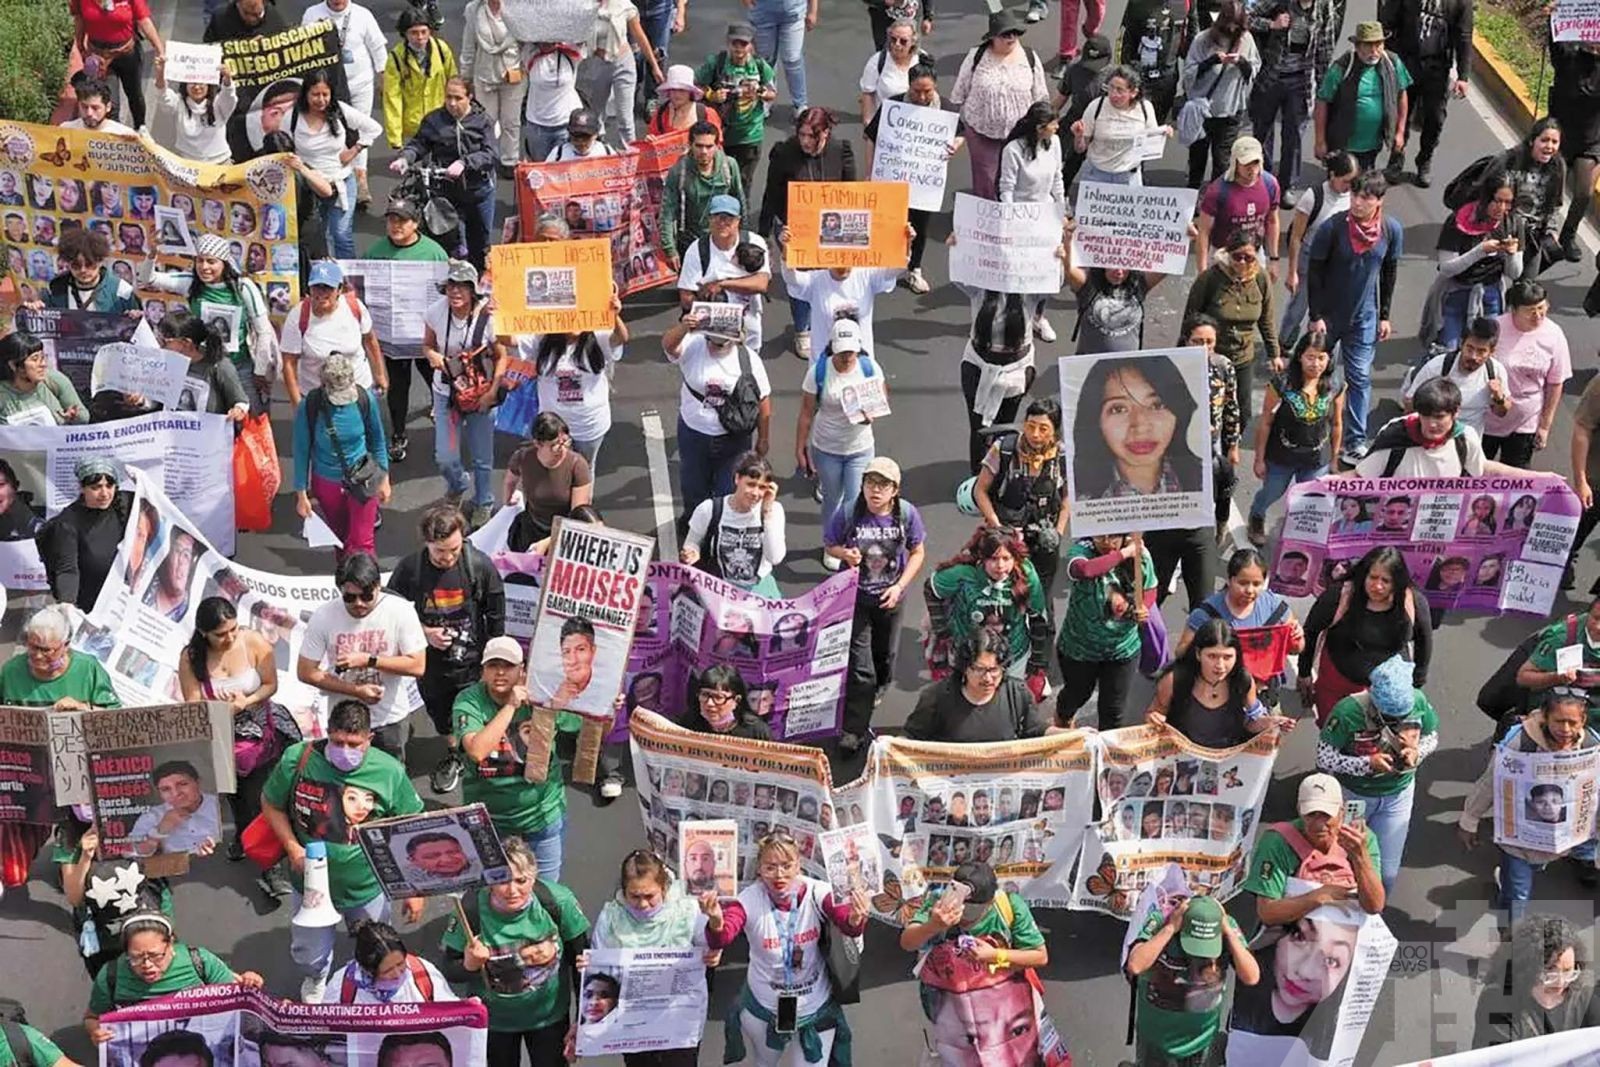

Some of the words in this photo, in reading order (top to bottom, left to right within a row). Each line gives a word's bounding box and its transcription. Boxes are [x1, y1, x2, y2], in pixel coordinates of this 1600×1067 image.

[223, 40, 259, 55] SIGO
[261, 18, 334, 51] BUSCANDO
[223, 52, 280, 76] DIEGO
[282, 37, 326, 65] IVÁN
[258, 54, 339, 86] ENCONTRARTE
[887, 104, 922, 132] Cavan
[928, 123, 949, 135] con
[893, 169, 944, 187] SILENCIO
[1136, 196, 1178, 207] FAMILIA
[1165, 232, 1182, 243] NO
[66, 431, 111, 443] ¡HASTA
[114, 419, 202, 439] ENCONTRARLE!
[1328, 479, 1376, 492] HASTA
[1379, 478, 1488, 491] ENCONTRARLES
[1491, 478, 1535, 490] CDMX
[559, 528, 622, 570] WHERE
[623, 544, 643, 575] IS
[549, 558, 639, 611] MOISÉS
[648, 563, 738, 600] ONTRARLES
[687, 747, 749, 764] BUSCANDO
[174, 985, 232, 999] AYUDANOS
[233, 986, 242, 994] A
[287, 1004, 311, 1016] JOEL
[311, 1005, 363, 1017] MARTINEZ
[363, 1006, 378, 1016] DE
[378, 1006, 391, 1016] LA
[393, 1003, 420, 1015] ROSA
